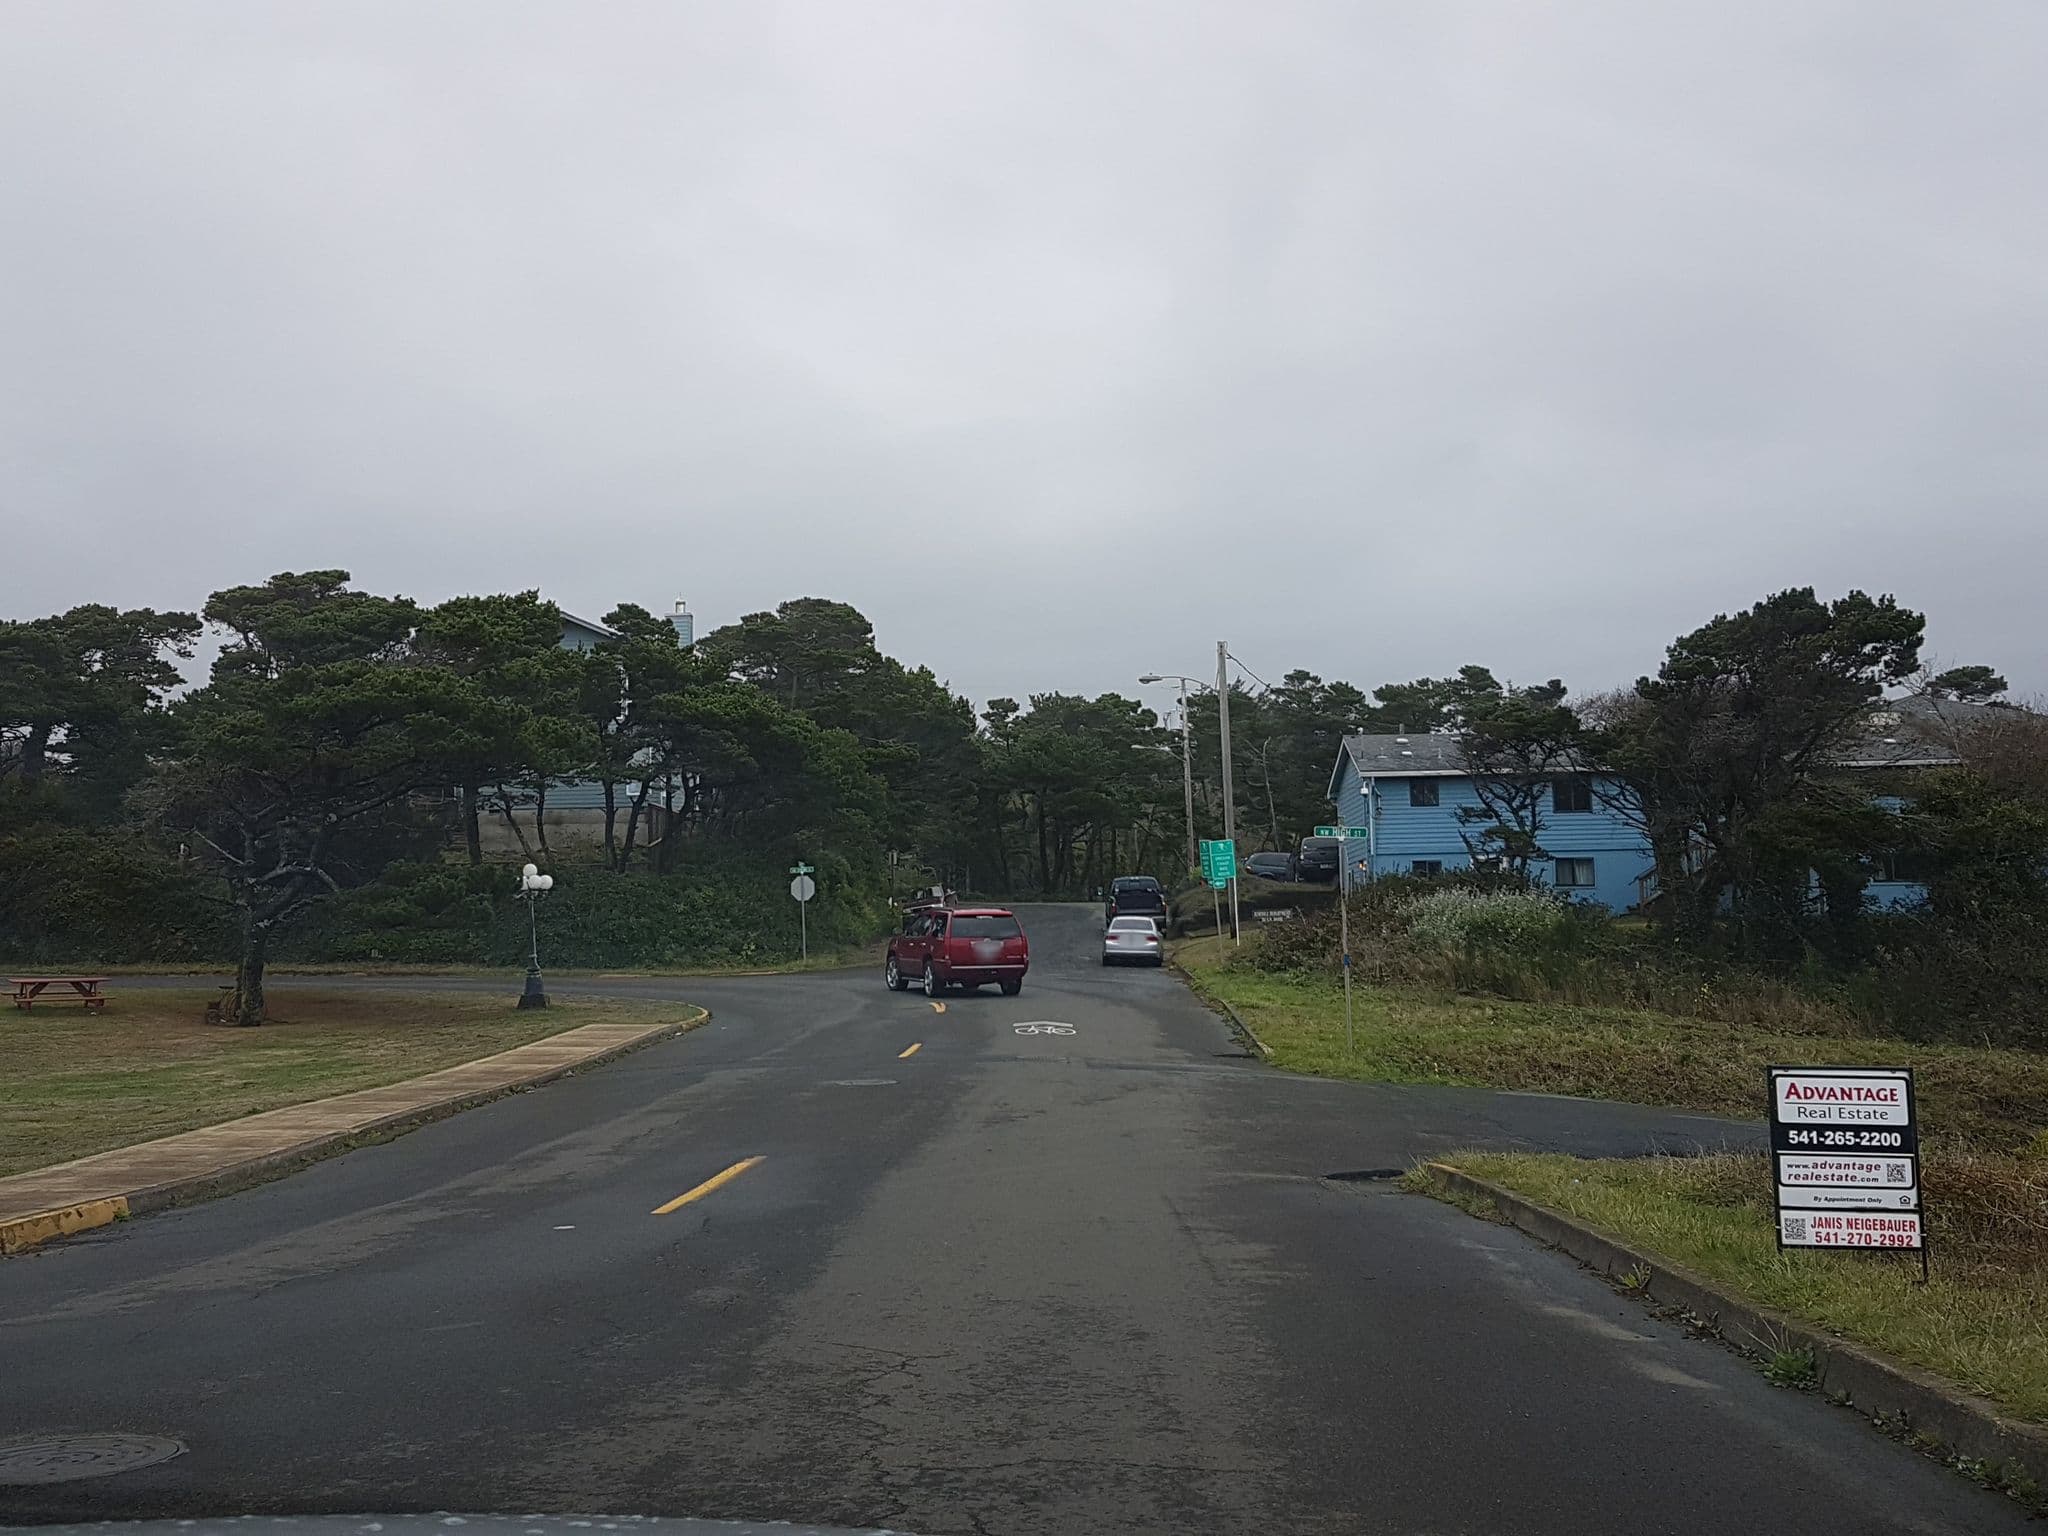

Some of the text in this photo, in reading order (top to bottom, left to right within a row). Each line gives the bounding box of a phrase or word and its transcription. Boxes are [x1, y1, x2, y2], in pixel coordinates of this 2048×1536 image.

[1333, 828, 1350, 837] HIGH
[1784, 1082, 1899, 1102] ADVANTAGE
[1797, 1106, 1889, 1120] Real Estate
[1788, 1130, 1901, 1146] 541-265-2200
[1786, 1160, 1882, 1173] www.advantage
[1787, 1172, 1880, 1183] realestate.com
[1823, 1196, 1866, 1204] Appointment
[1810, 1216, 1917, 1233] JANIS NEIGEBAUER
[1815, 1232, 1914, 1246] 541-270-2992
